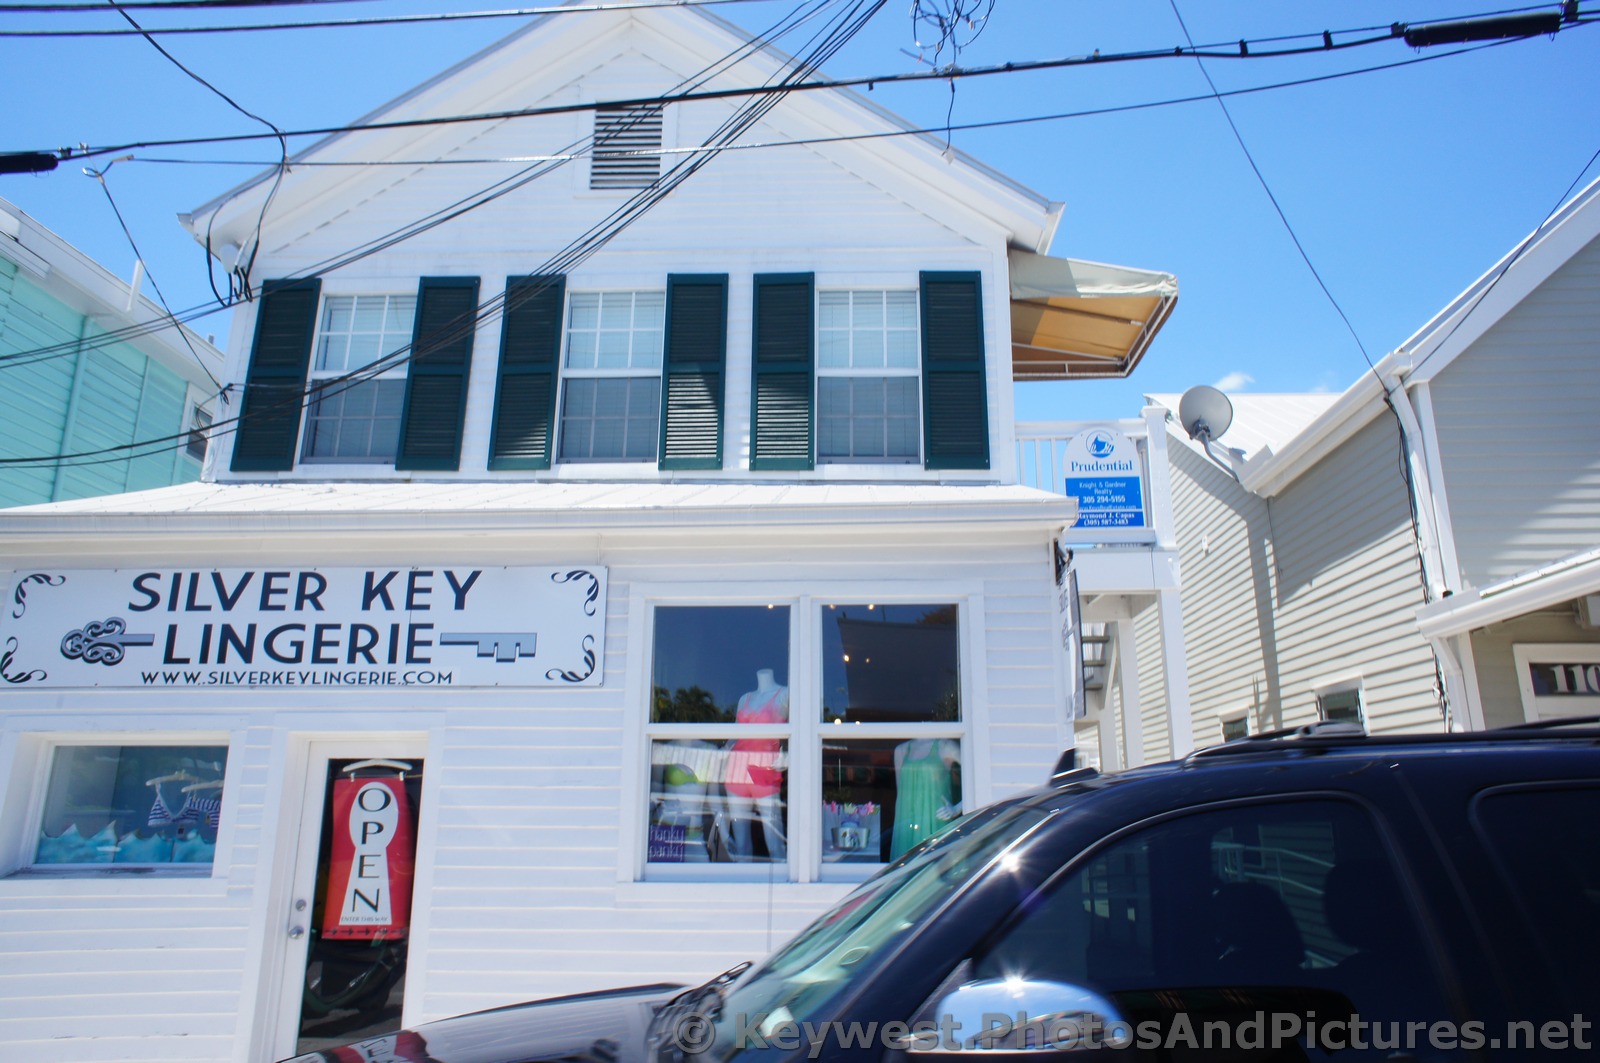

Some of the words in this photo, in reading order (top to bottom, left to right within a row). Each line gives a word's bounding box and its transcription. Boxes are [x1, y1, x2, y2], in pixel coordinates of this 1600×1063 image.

[1071, 460, 1133, 472] Prudential
[1079, 481, 1097, 490] Knight
[1094, 488, 1113, 496] Realty
[1083, 496, 1096, 504] 305
[1097, 495, 1126, 503] 294-5155
[1108, 511, 1114, 519] J.
[1083, 519, 1100, 527] (305)
[128, 571, 328, 612] SILVER
[362, 570, 483, 611] KEY
[163, 623, 435, 665] LINGERIE
[141, 670, 453, 686] WWW.SILVERKEYLINGERIE.COM
[352, 788, 391, 913] OPEN
